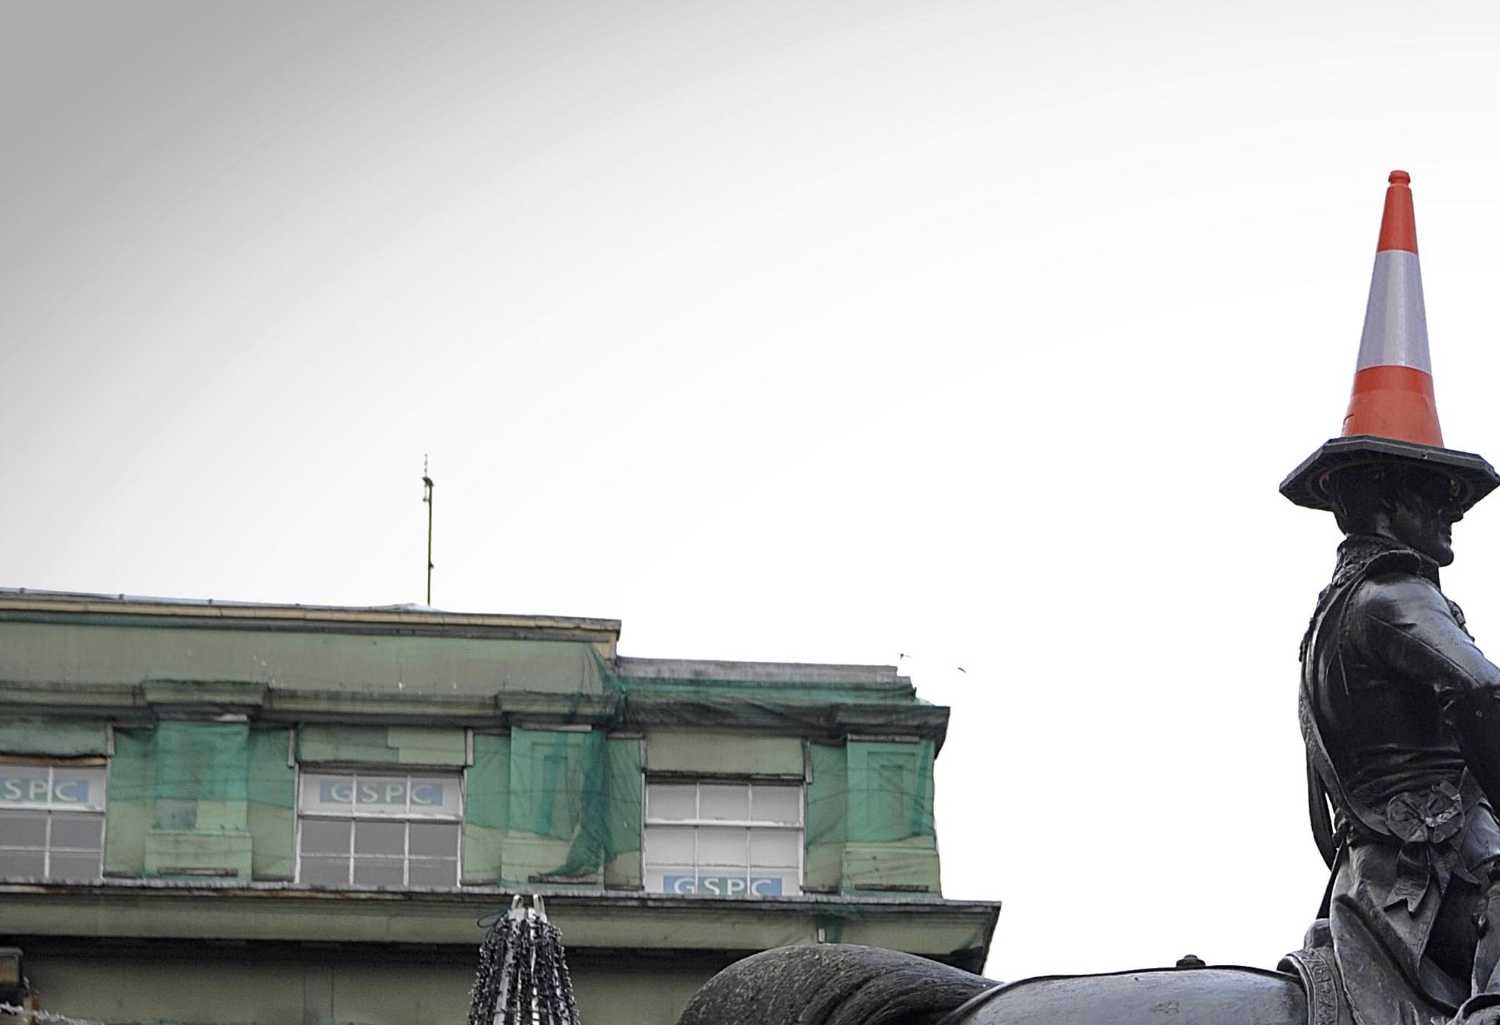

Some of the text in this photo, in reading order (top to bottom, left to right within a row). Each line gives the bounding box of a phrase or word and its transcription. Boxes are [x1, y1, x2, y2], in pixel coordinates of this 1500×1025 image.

[0, 780, 80, 801] SPC
[331, 783, 433, 804] GSPC
[673, 877, 773, 896] GSPC
